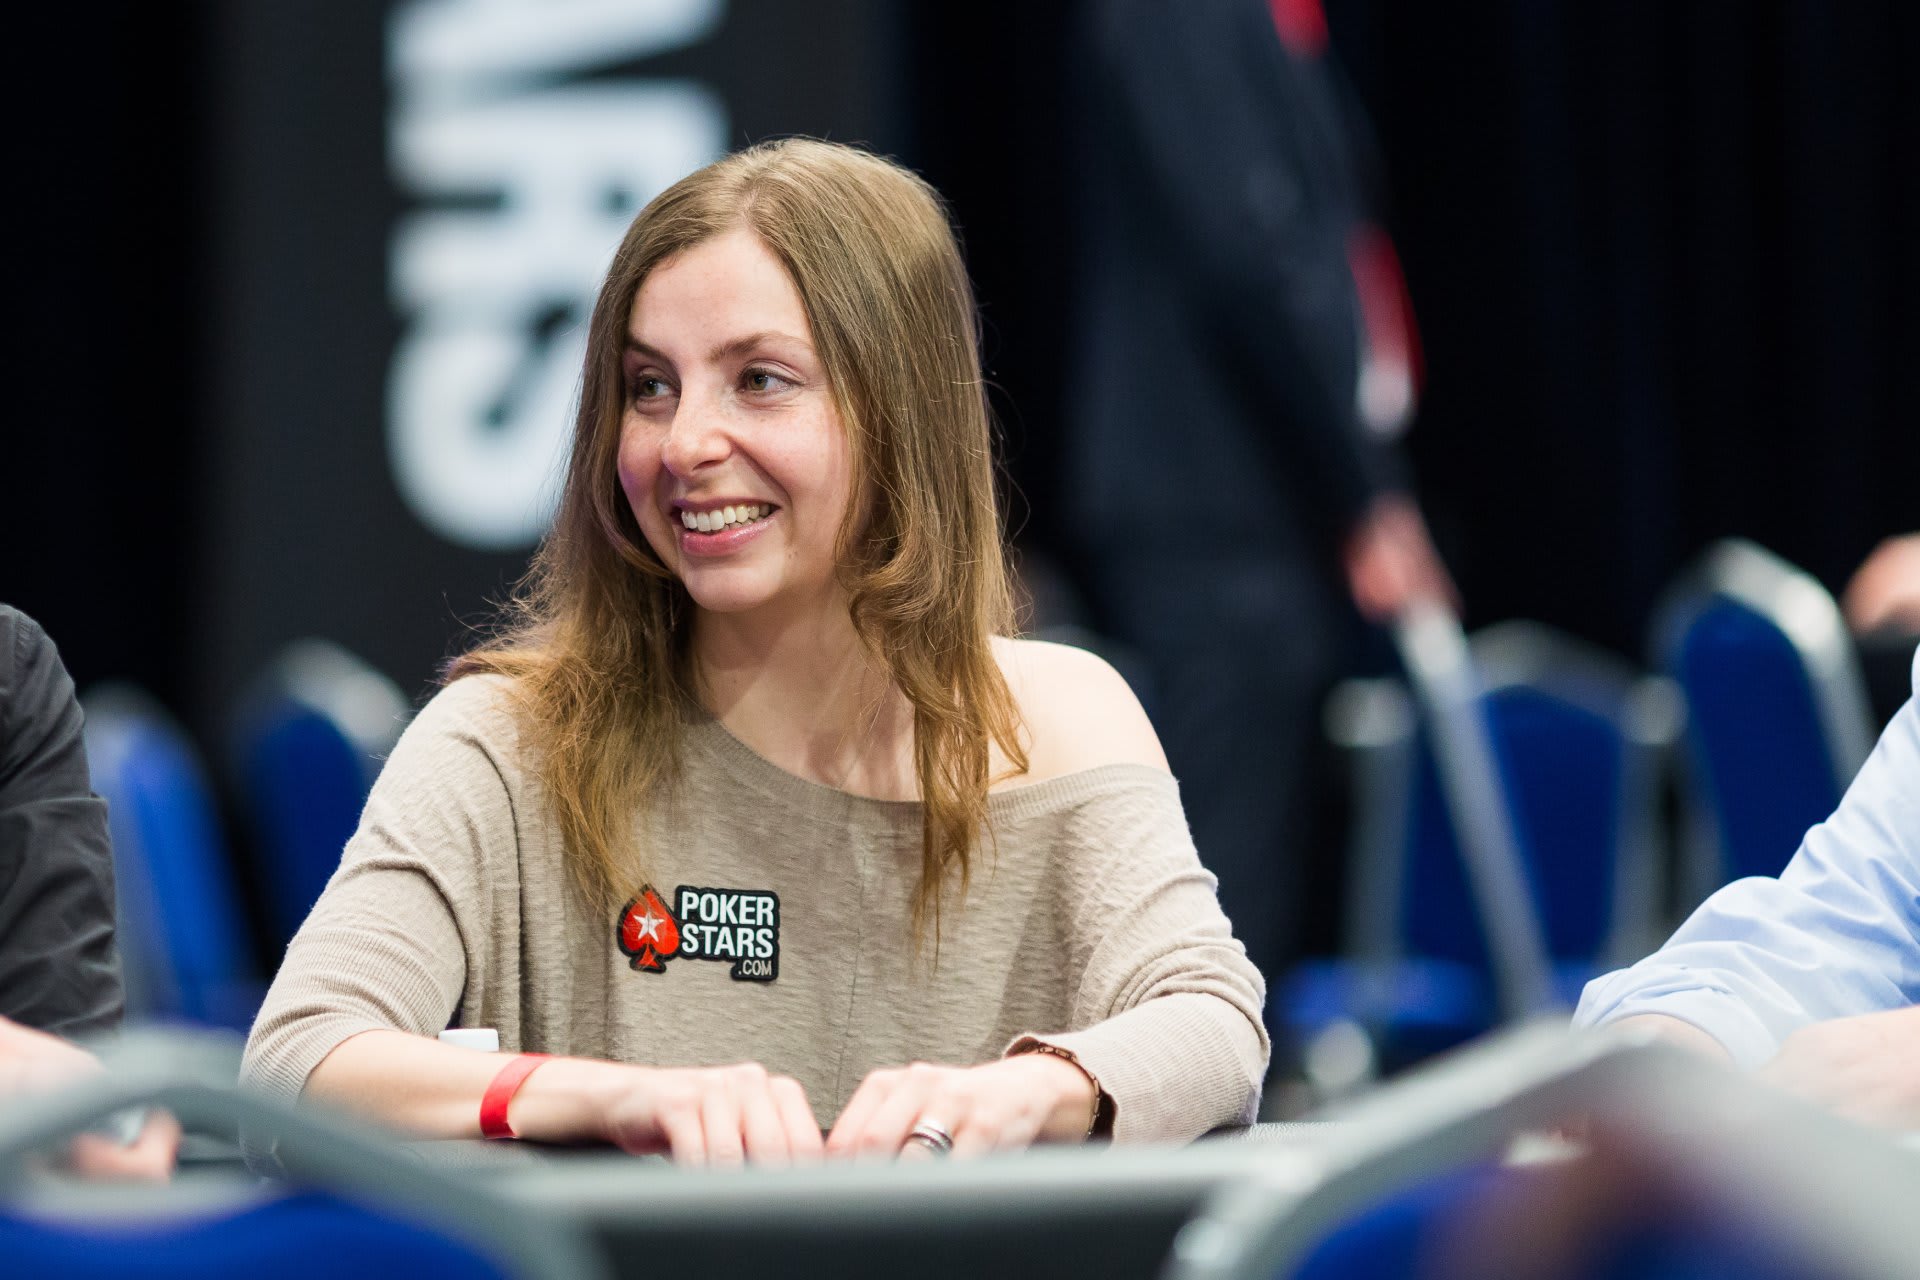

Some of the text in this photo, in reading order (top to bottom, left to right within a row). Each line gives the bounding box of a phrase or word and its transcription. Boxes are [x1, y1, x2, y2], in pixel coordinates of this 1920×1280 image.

[681, 891, 774, 926] POKER
[681, 923, 774, 958] STARS
[738, 959, 772, 976] .COM
